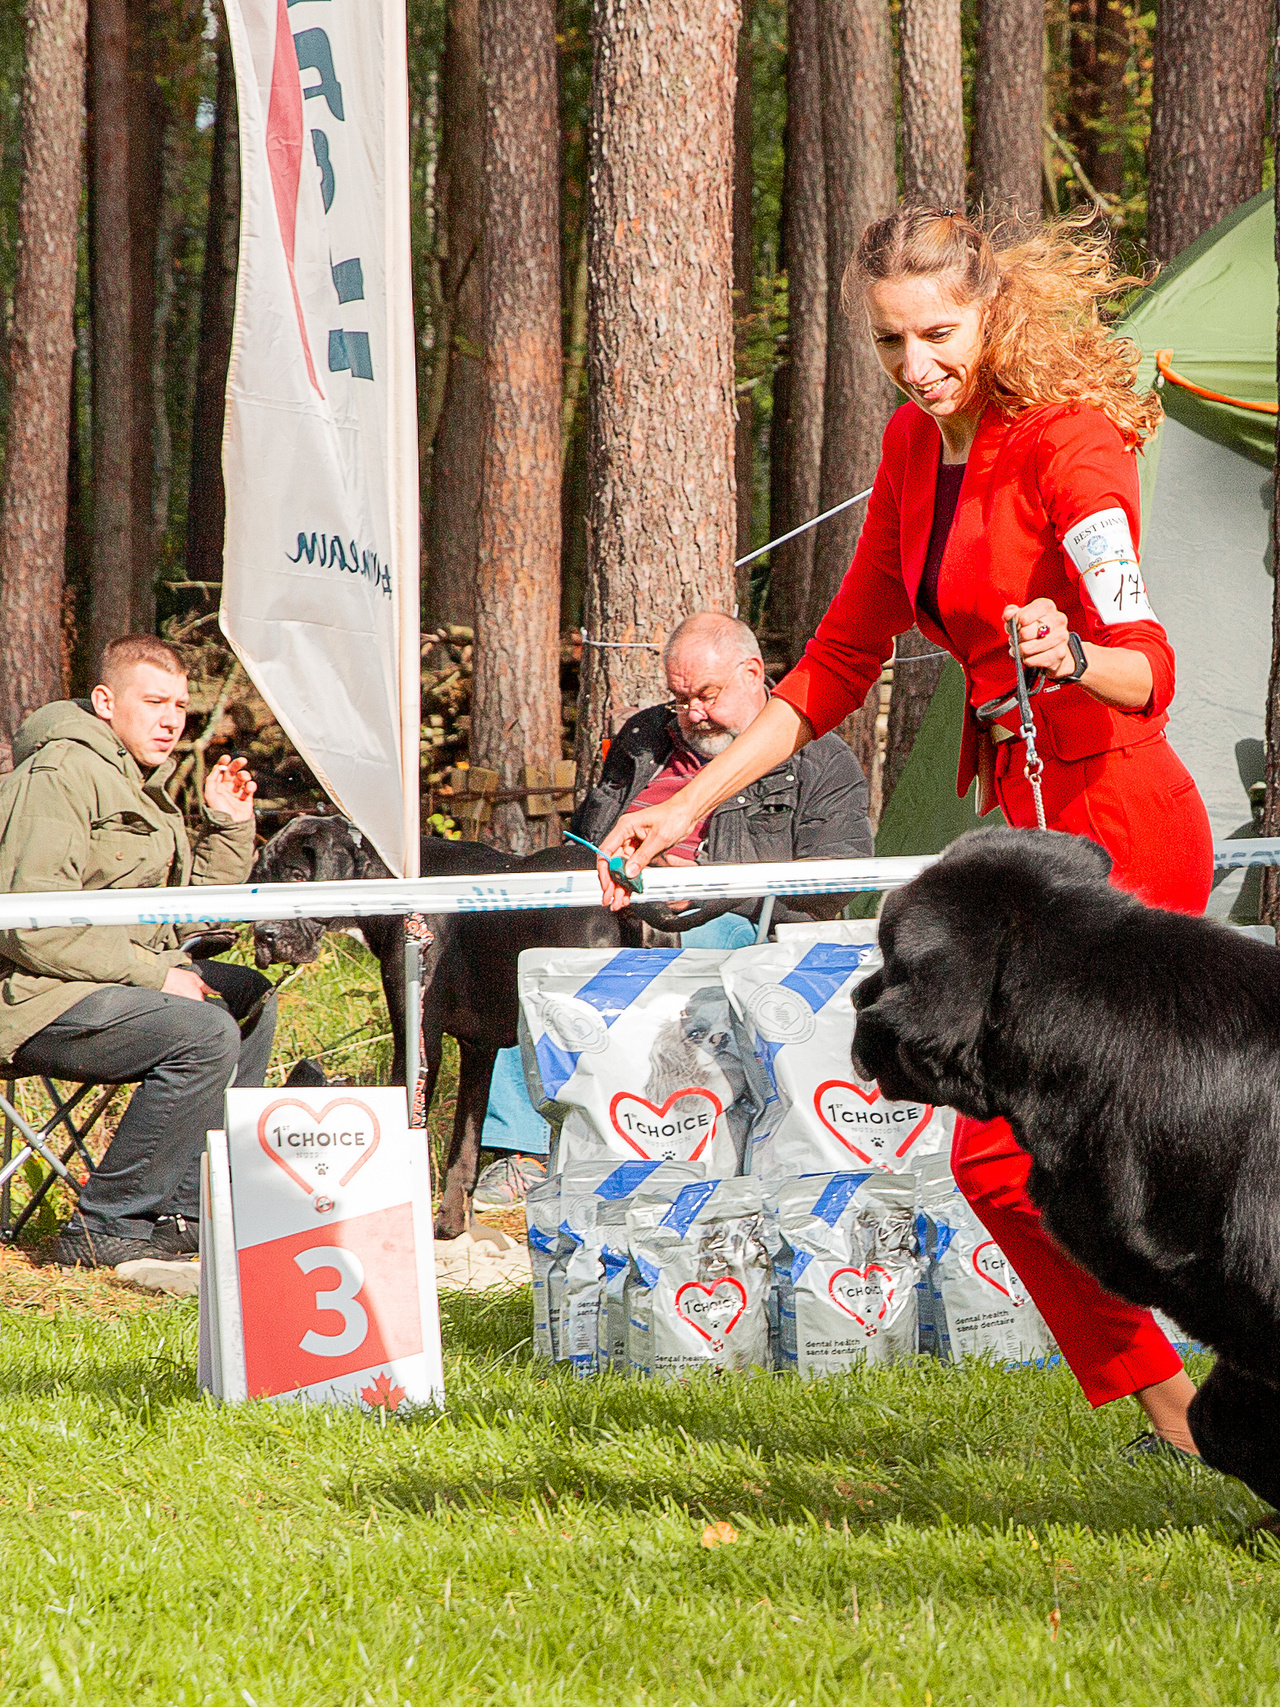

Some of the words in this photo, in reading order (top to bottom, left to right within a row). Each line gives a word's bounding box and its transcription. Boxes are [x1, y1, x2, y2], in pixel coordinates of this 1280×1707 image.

[1073, 523, 1098, 545] BEST
[1113, 573, 1150, 611] 17
[636, 1113, 709, 1138] CHOICE
[842, 1107, 919, 1124] CHOICE
[287, 1132, 365, 1147] CHOICE
[293, 1245, 368, 1357] 3
